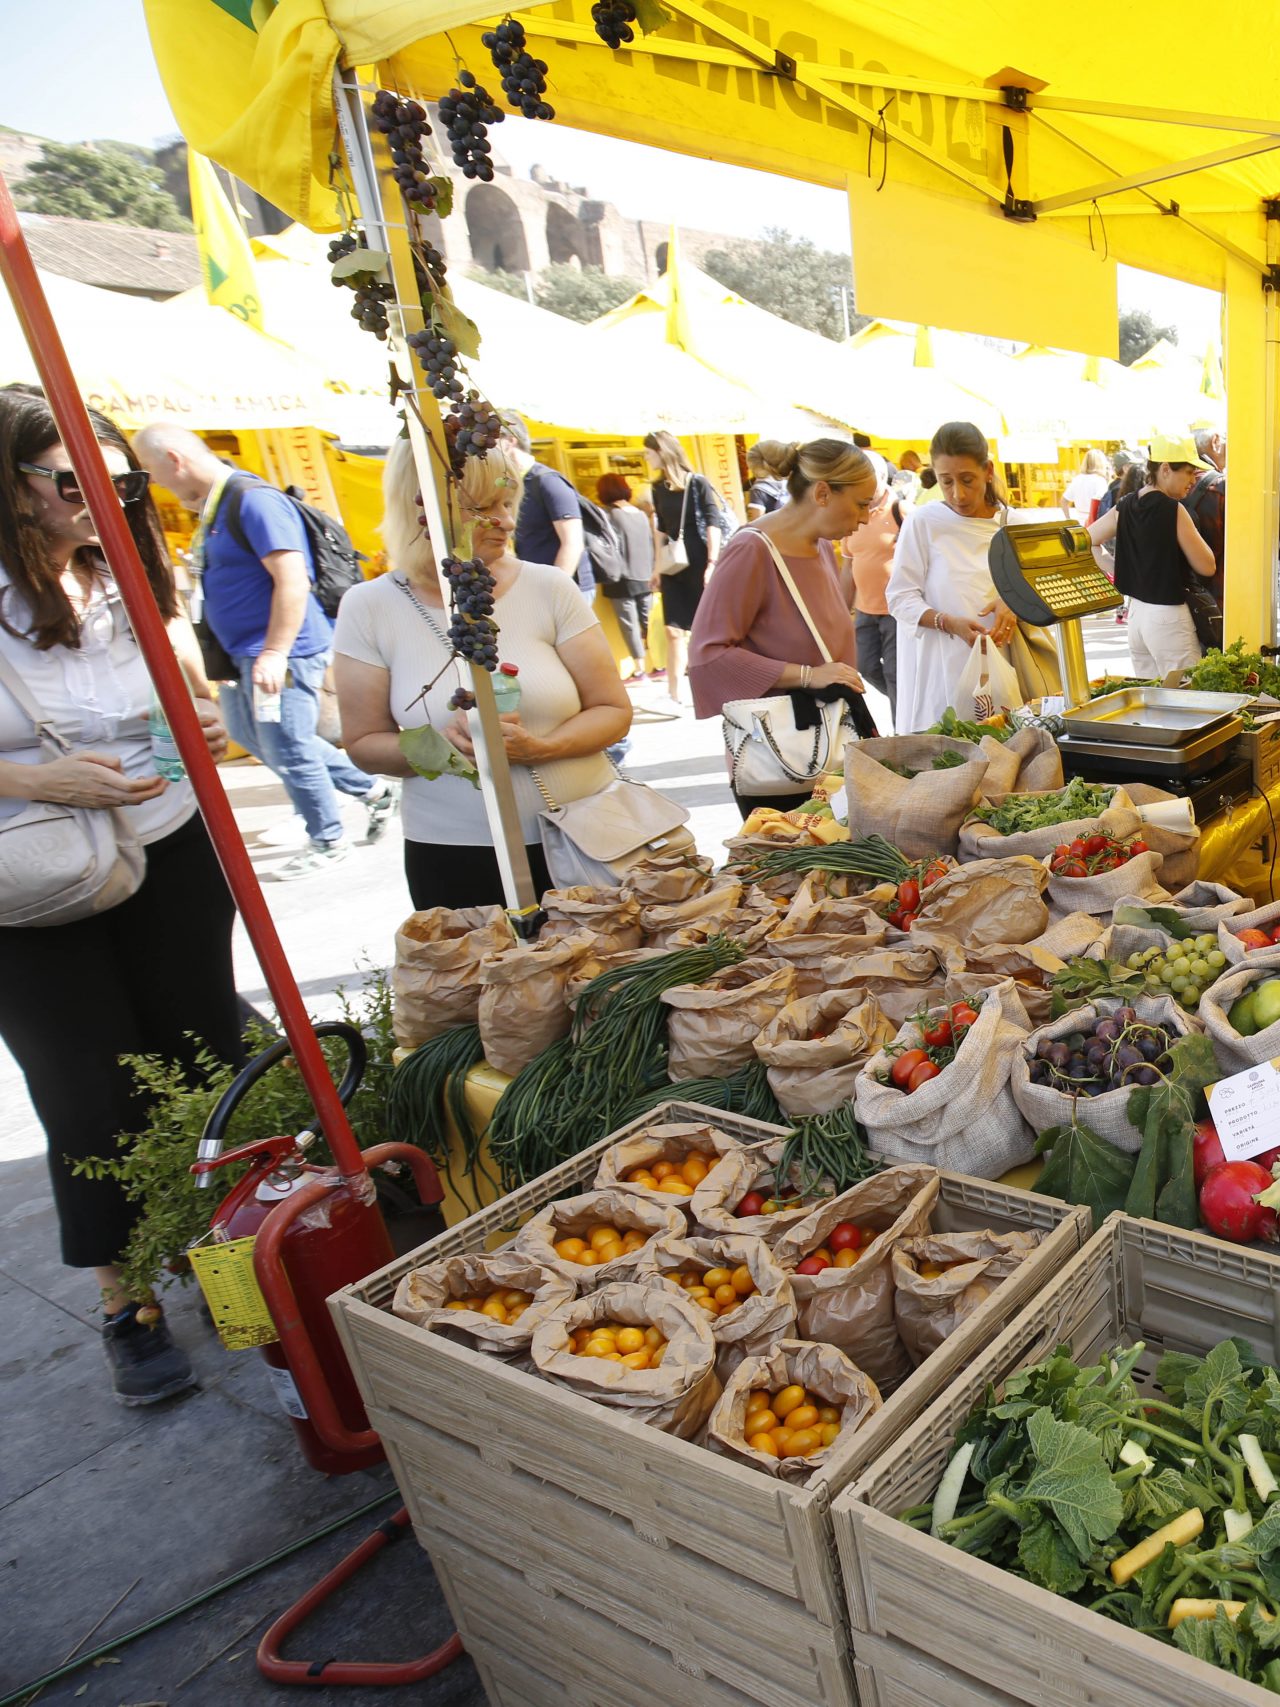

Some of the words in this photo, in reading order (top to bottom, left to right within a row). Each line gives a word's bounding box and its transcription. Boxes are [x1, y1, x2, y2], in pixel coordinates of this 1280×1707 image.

[89, 394, 223, 412] CAMPAGA
[1224, 1102, 1246, 1114] PREZZO
[1228, 1110, 1258, 1125] PRODOTTO
[1236, 1136, 1259, 1150] ORIGINE
